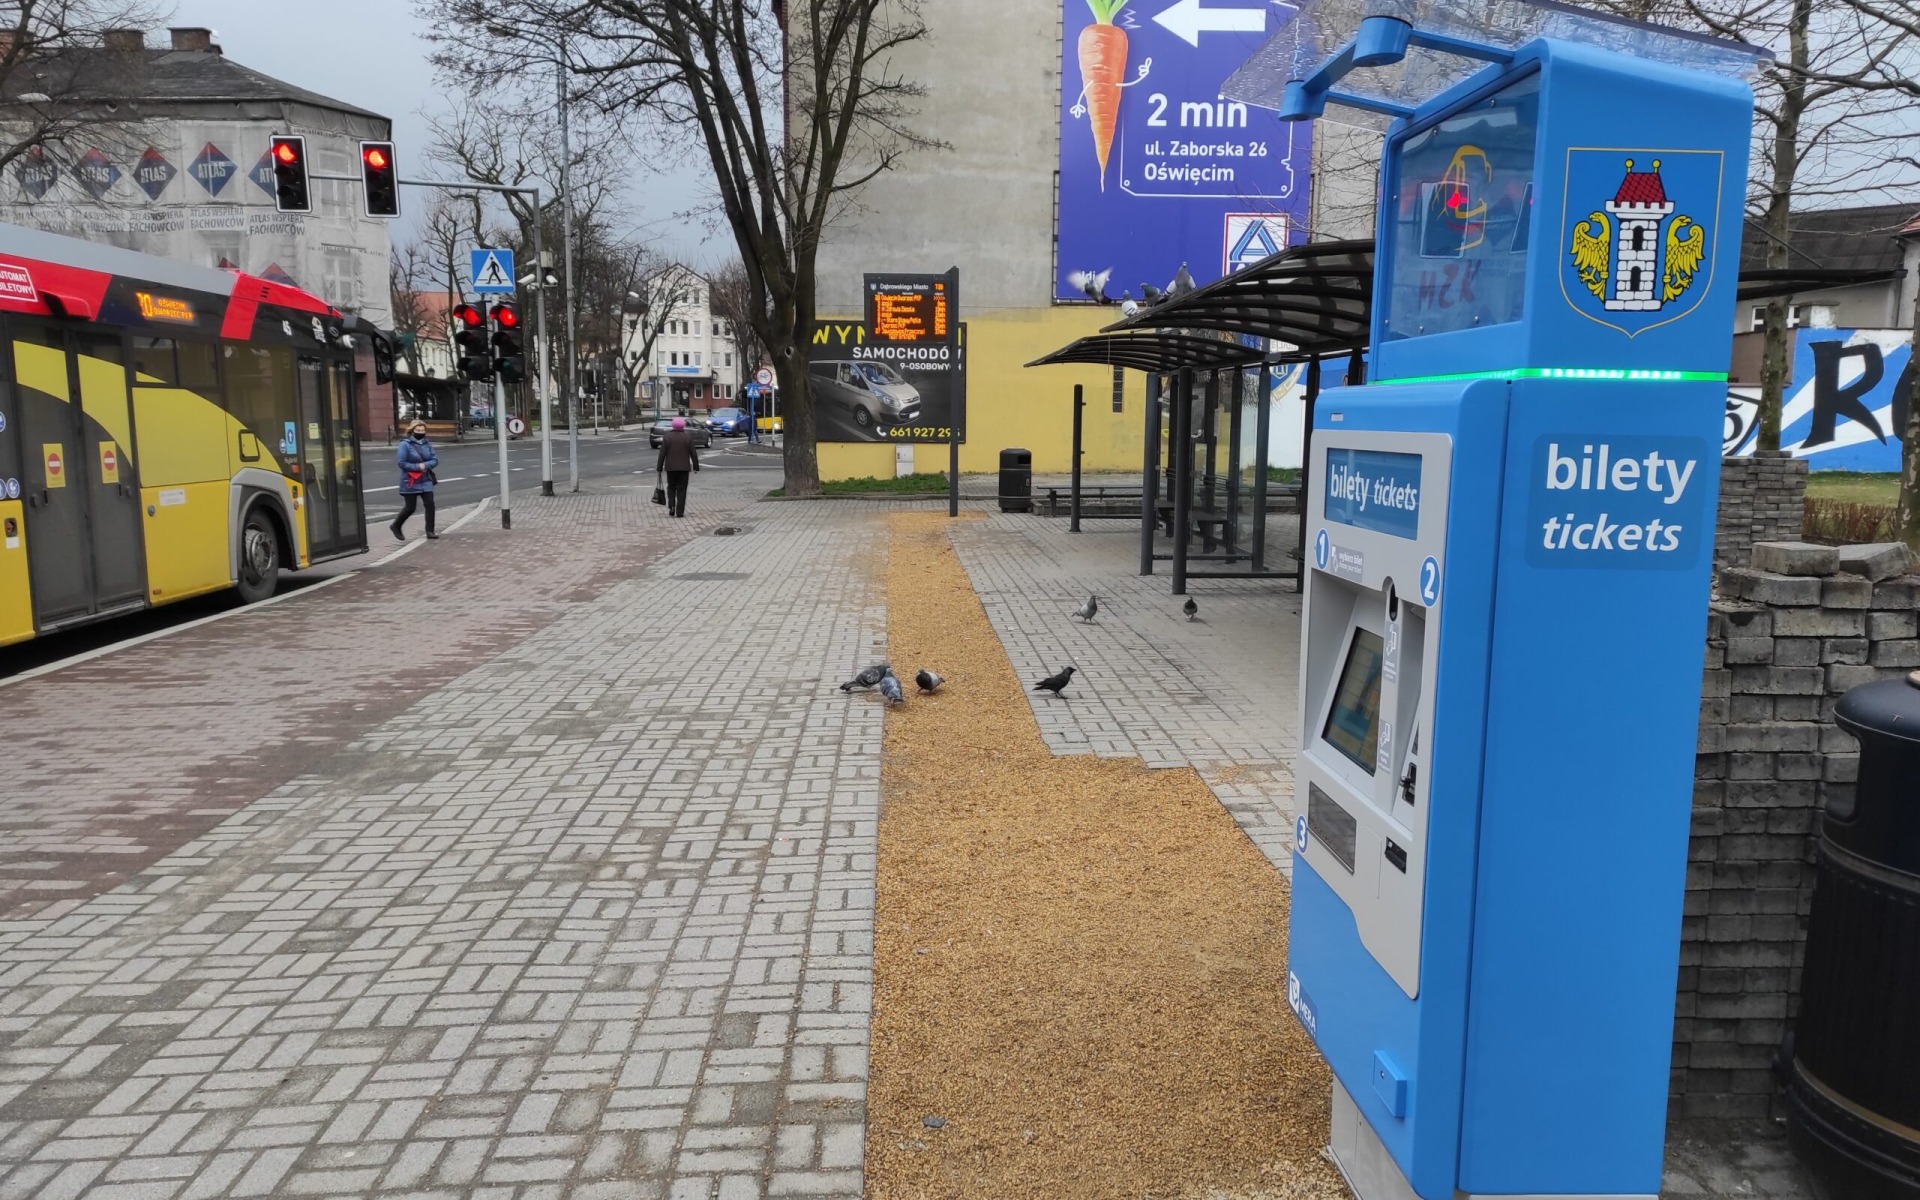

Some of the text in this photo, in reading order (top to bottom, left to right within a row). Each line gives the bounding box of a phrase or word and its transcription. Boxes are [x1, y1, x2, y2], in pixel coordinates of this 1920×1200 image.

[1147, 93, 1248, 128] 2 min
[1145, 140, 1268, 157] ul. Zaborska 26
[140, 165, 167, 184] ATLAS
[197, 161, 226, 179] ATLAS
[1144, 163, 1235, 185] Oświęcim
[130, 209, 184, 221] ATLAS WSPIERA
[190, 206, 244, 217] ATLAS WSPIERA
[250, 213, 304, 224] ATLAS WSPIERA
[129, 220, 185, 233] FACHOWCÓW
[190, 216, 245, 229] FACHOWCÓW
[250, 222, 305, 236] FACHOWCÓW
[0, 270, 28, 283] UTOMAT
[880, 283, 912, 291] Dąbrowskiego
[852, 345, 962, 360] SAMOCHODÓ
[900, 362, 962, 371] 9-OSOBOWY
[889, 427, 960, 438] 661 927 29
[1546, 443, 1697, 504] bilety
[1330, 463, 1418, 512] bilety tickets
[1543, 513, 1683, 551] tickets
[1318, 533, 1326, 565] 1
[1423, 562, 1436, 600] 2
[1298, 820, 1307, 849] 3
